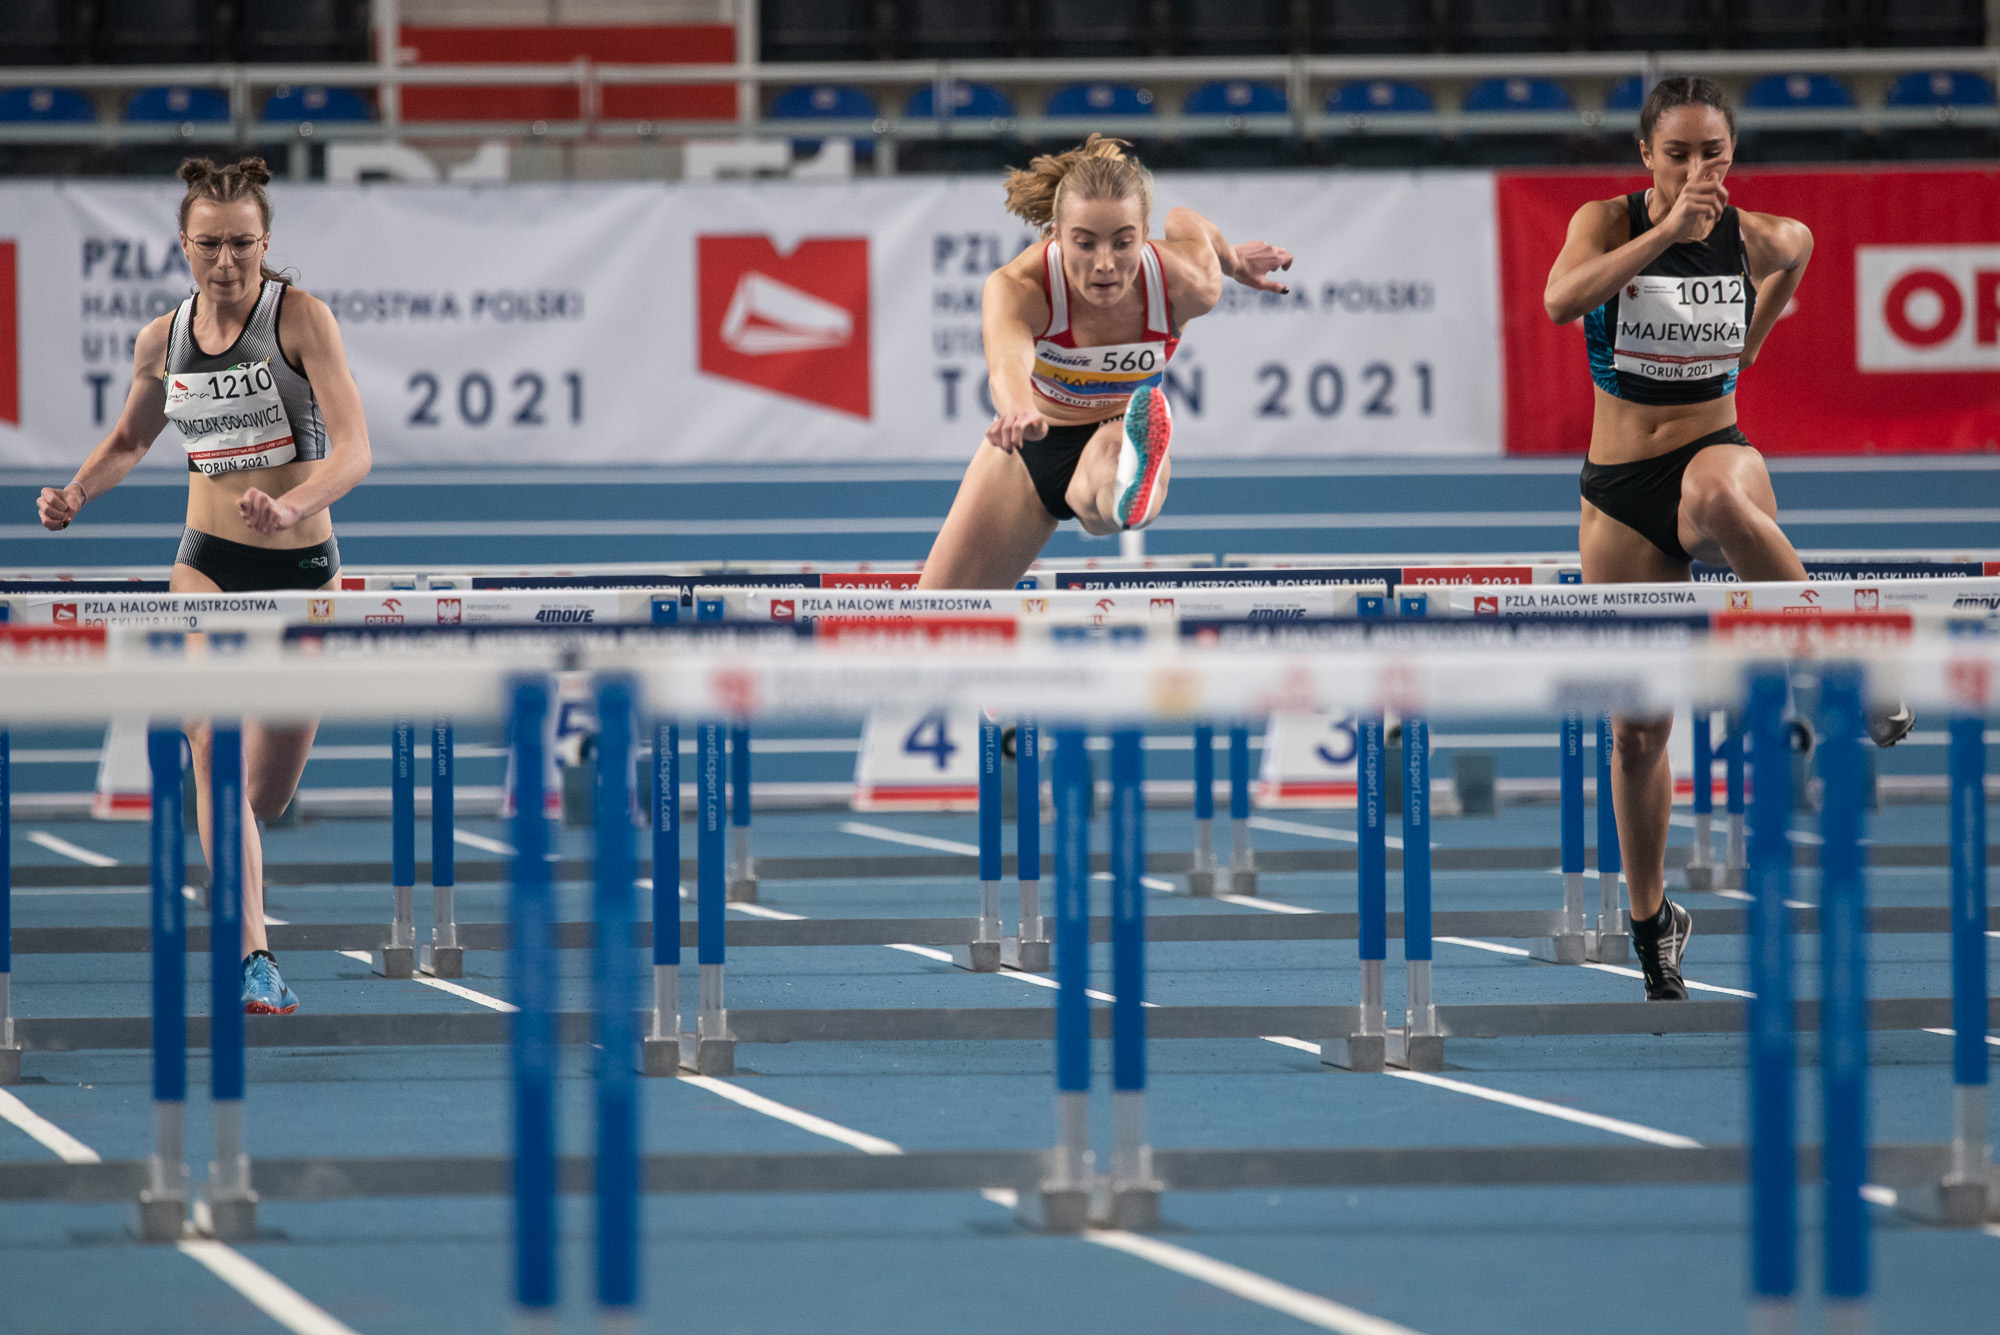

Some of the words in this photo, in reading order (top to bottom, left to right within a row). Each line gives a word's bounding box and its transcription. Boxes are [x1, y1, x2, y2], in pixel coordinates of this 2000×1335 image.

[1676, 280, 1744, 305] 1012
[1621, 321, 1741, 342] MAJEWSKA
[1100, 350, 1155, 372] 560
[1640, 363, 1683, 378] TORUŃ
[1687, 363, 1713, 378] 2021
[207, 367, 273, 400] 1210
[1256, 363, 1433, 418] 2021
[408, 371, 583, 427] 2021
[200, 457, 237, 474] TORUŃ
[241, 455, 269, 470] 2021
[84, 602, 116, 613] PZLA
[121, 600, 178, 613] HALOWE
[183, 599, 277, 612] MISTRZOSTWA
[802, 600, 832, 611] PZLA
[837, 599, 895, 611] HALOWE
[900, 599, 992, 610] MISTRZOSTWA
[1505, 596, 1536, 607] PZLA
[1541, 595, 1598, 606] HALOWE
[1603, 592, 1696, 605] MISTRZOSTWA
[367, 616, 402, 625] ORLEN
[535, 610, 595, 623] 4MOVE
[903, 704, 958, 771] 4
[1316, 708, 1358, 767] 3
[658, 726, 673, 832] nordicsport.com
[705, 725, 718, 832] nordicsport.com
[1365, 721, 1379, 828] nordicsport.com
[1409, 719, 1423, 826] nordicsport.com
